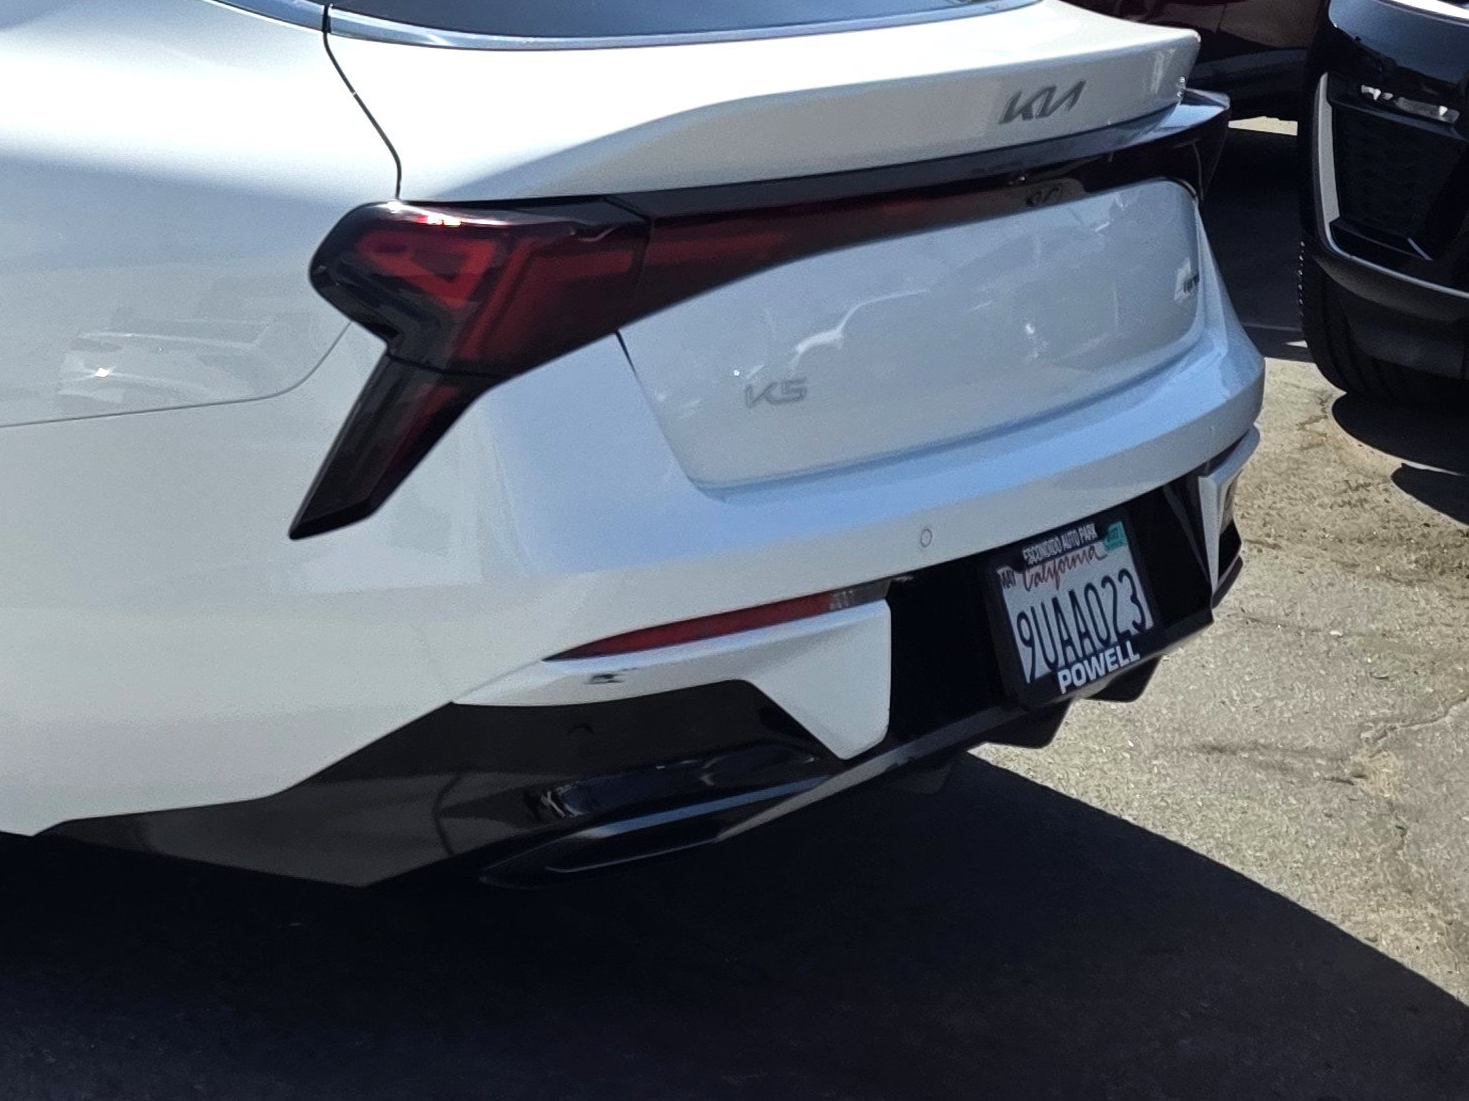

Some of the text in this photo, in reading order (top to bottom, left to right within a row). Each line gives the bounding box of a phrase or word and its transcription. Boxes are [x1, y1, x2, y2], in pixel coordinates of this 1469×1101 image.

[999, 80, 1086, 125] KIA
[744, 377, 808, 408] K5
[1023, 544, 1108, 592] California
[1016, 567, 1147, 685] 9UAA023
[1057, 639, 1141, 695] POWELL
